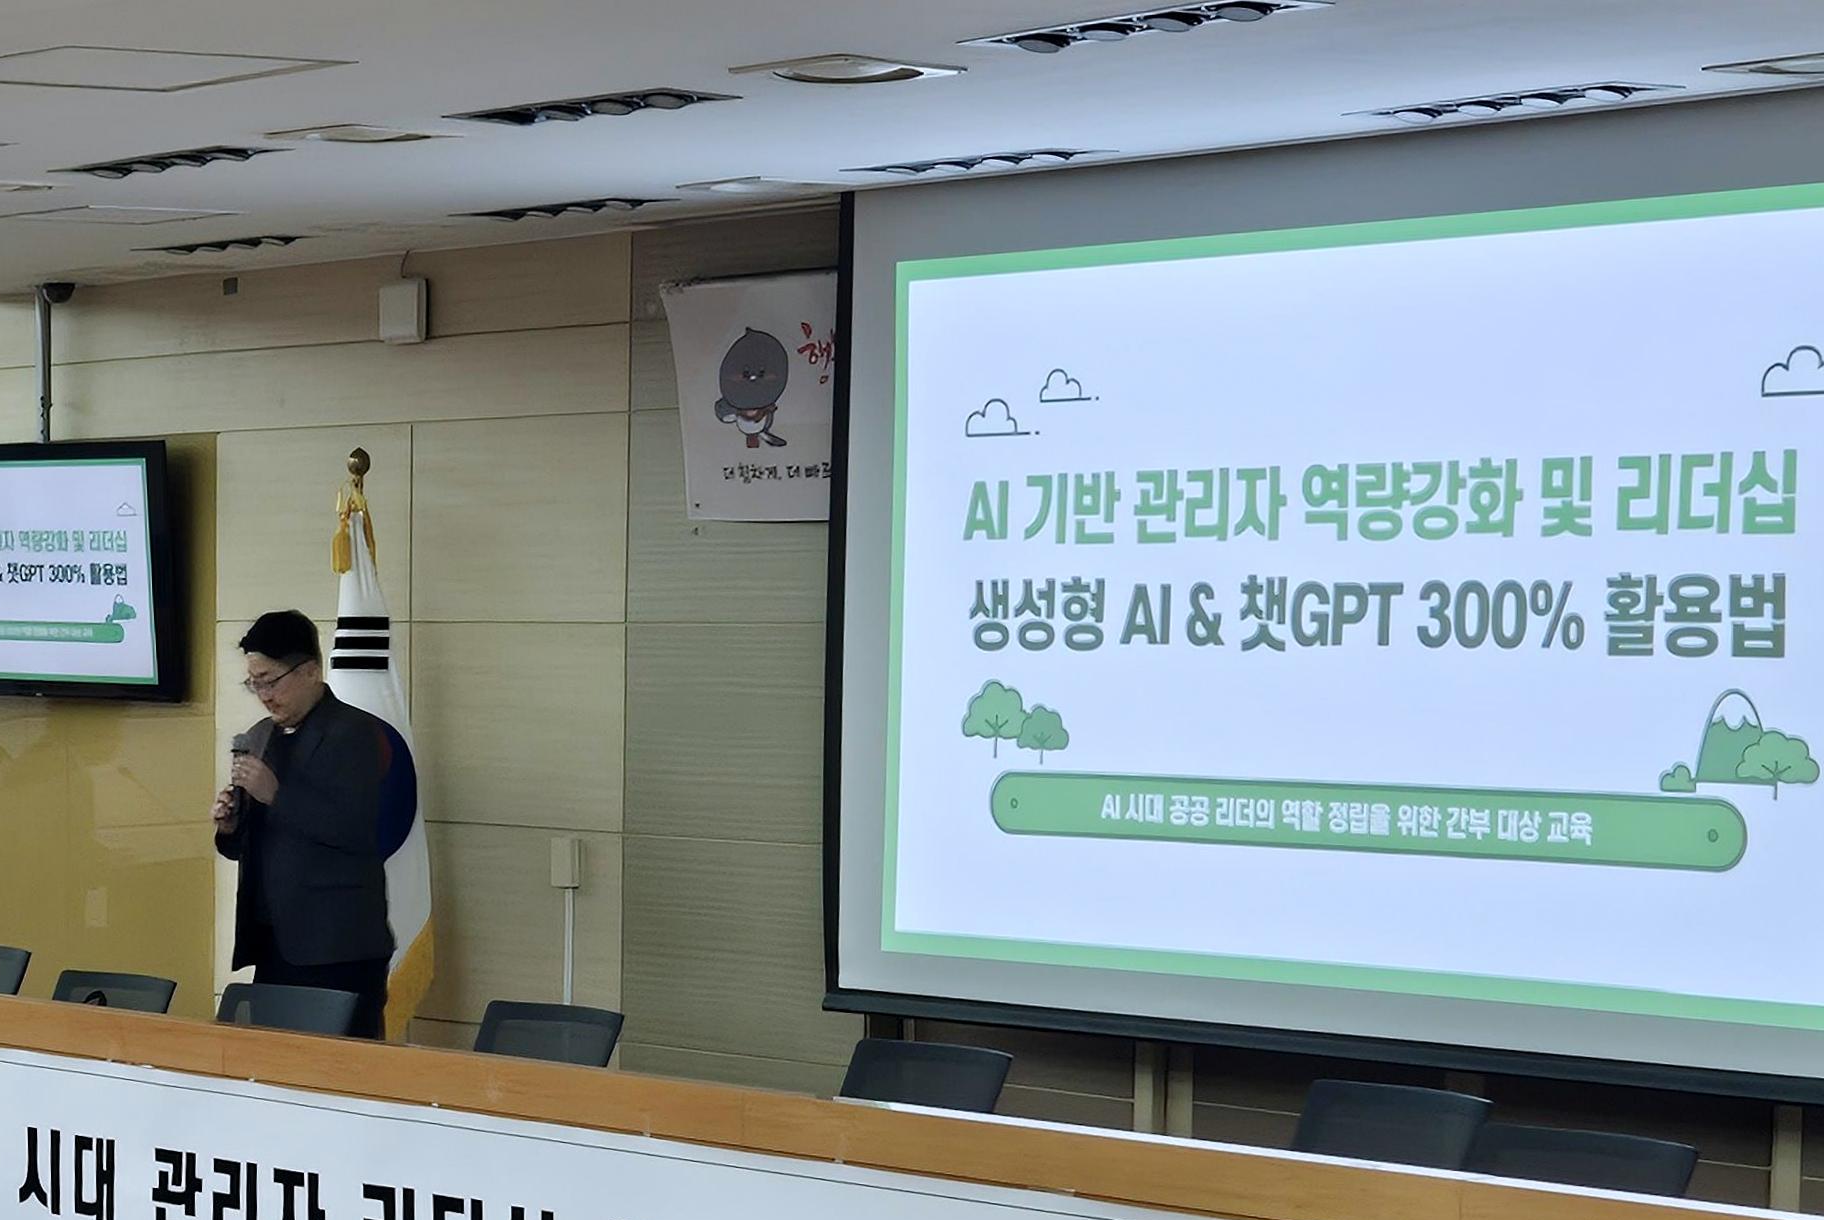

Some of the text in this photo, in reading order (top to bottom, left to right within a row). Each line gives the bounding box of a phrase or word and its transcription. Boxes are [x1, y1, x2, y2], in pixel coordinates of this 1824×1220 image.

[785, 464, 800, 479] 더
[963, 448, 1798, 545] AI 기반 관리자 역량강화 및 리더십
[18, 529, 69, 553] 역량강화
[72, 530, 85, 553] 및
[89, 530, 128, 553] 리더십
[7, 561, 45, 584] 챗GPT
[48, 563, 86, 584] 300%
[89, 562, 128, 586] 활용법
[969, 572, 1787, 659] 생성형 AI & 챗GPT 300% 활용법
[1101, 793, 1594, 846] AI 시대 공공 리더의 역할 정립을 위한 간부 대상 교육
